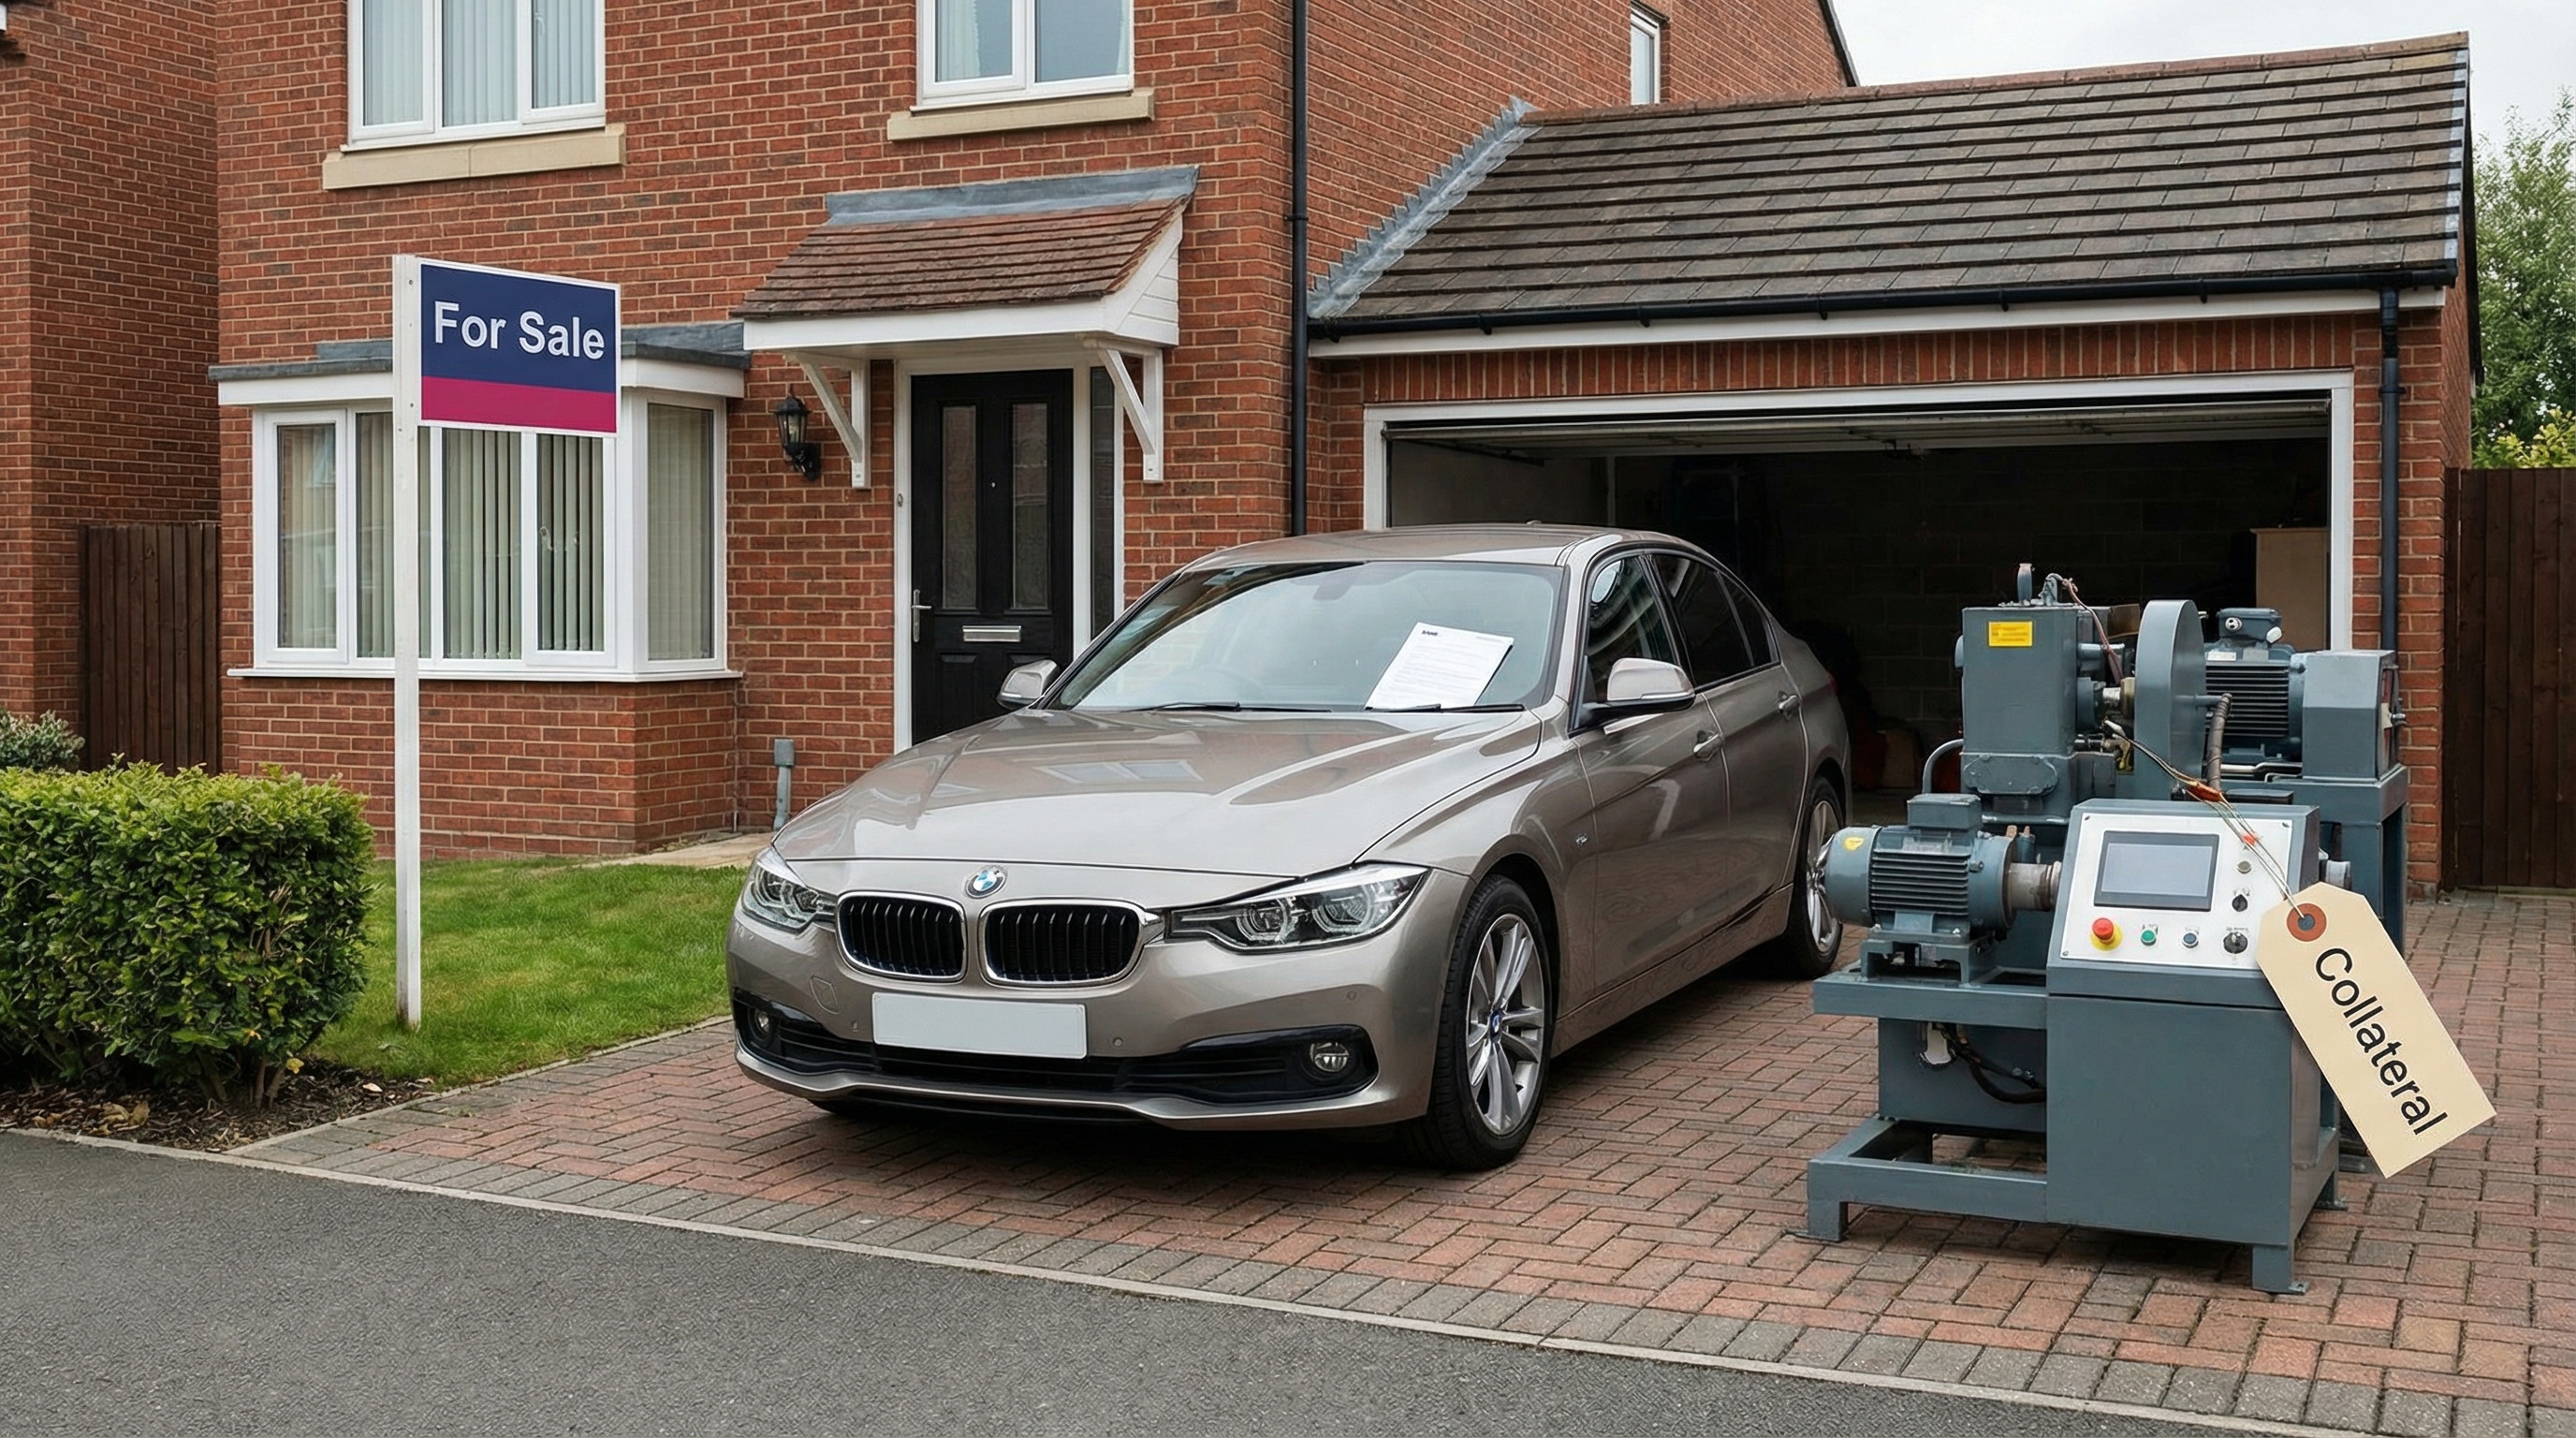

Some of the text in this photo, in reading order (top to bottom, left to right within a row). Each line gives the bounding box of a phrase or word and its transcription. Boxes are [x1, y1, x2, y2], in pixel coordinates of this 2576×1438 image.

[434, 301, 605, 360] For Sale
[2315, 947, 2448, 1136] Collateral
